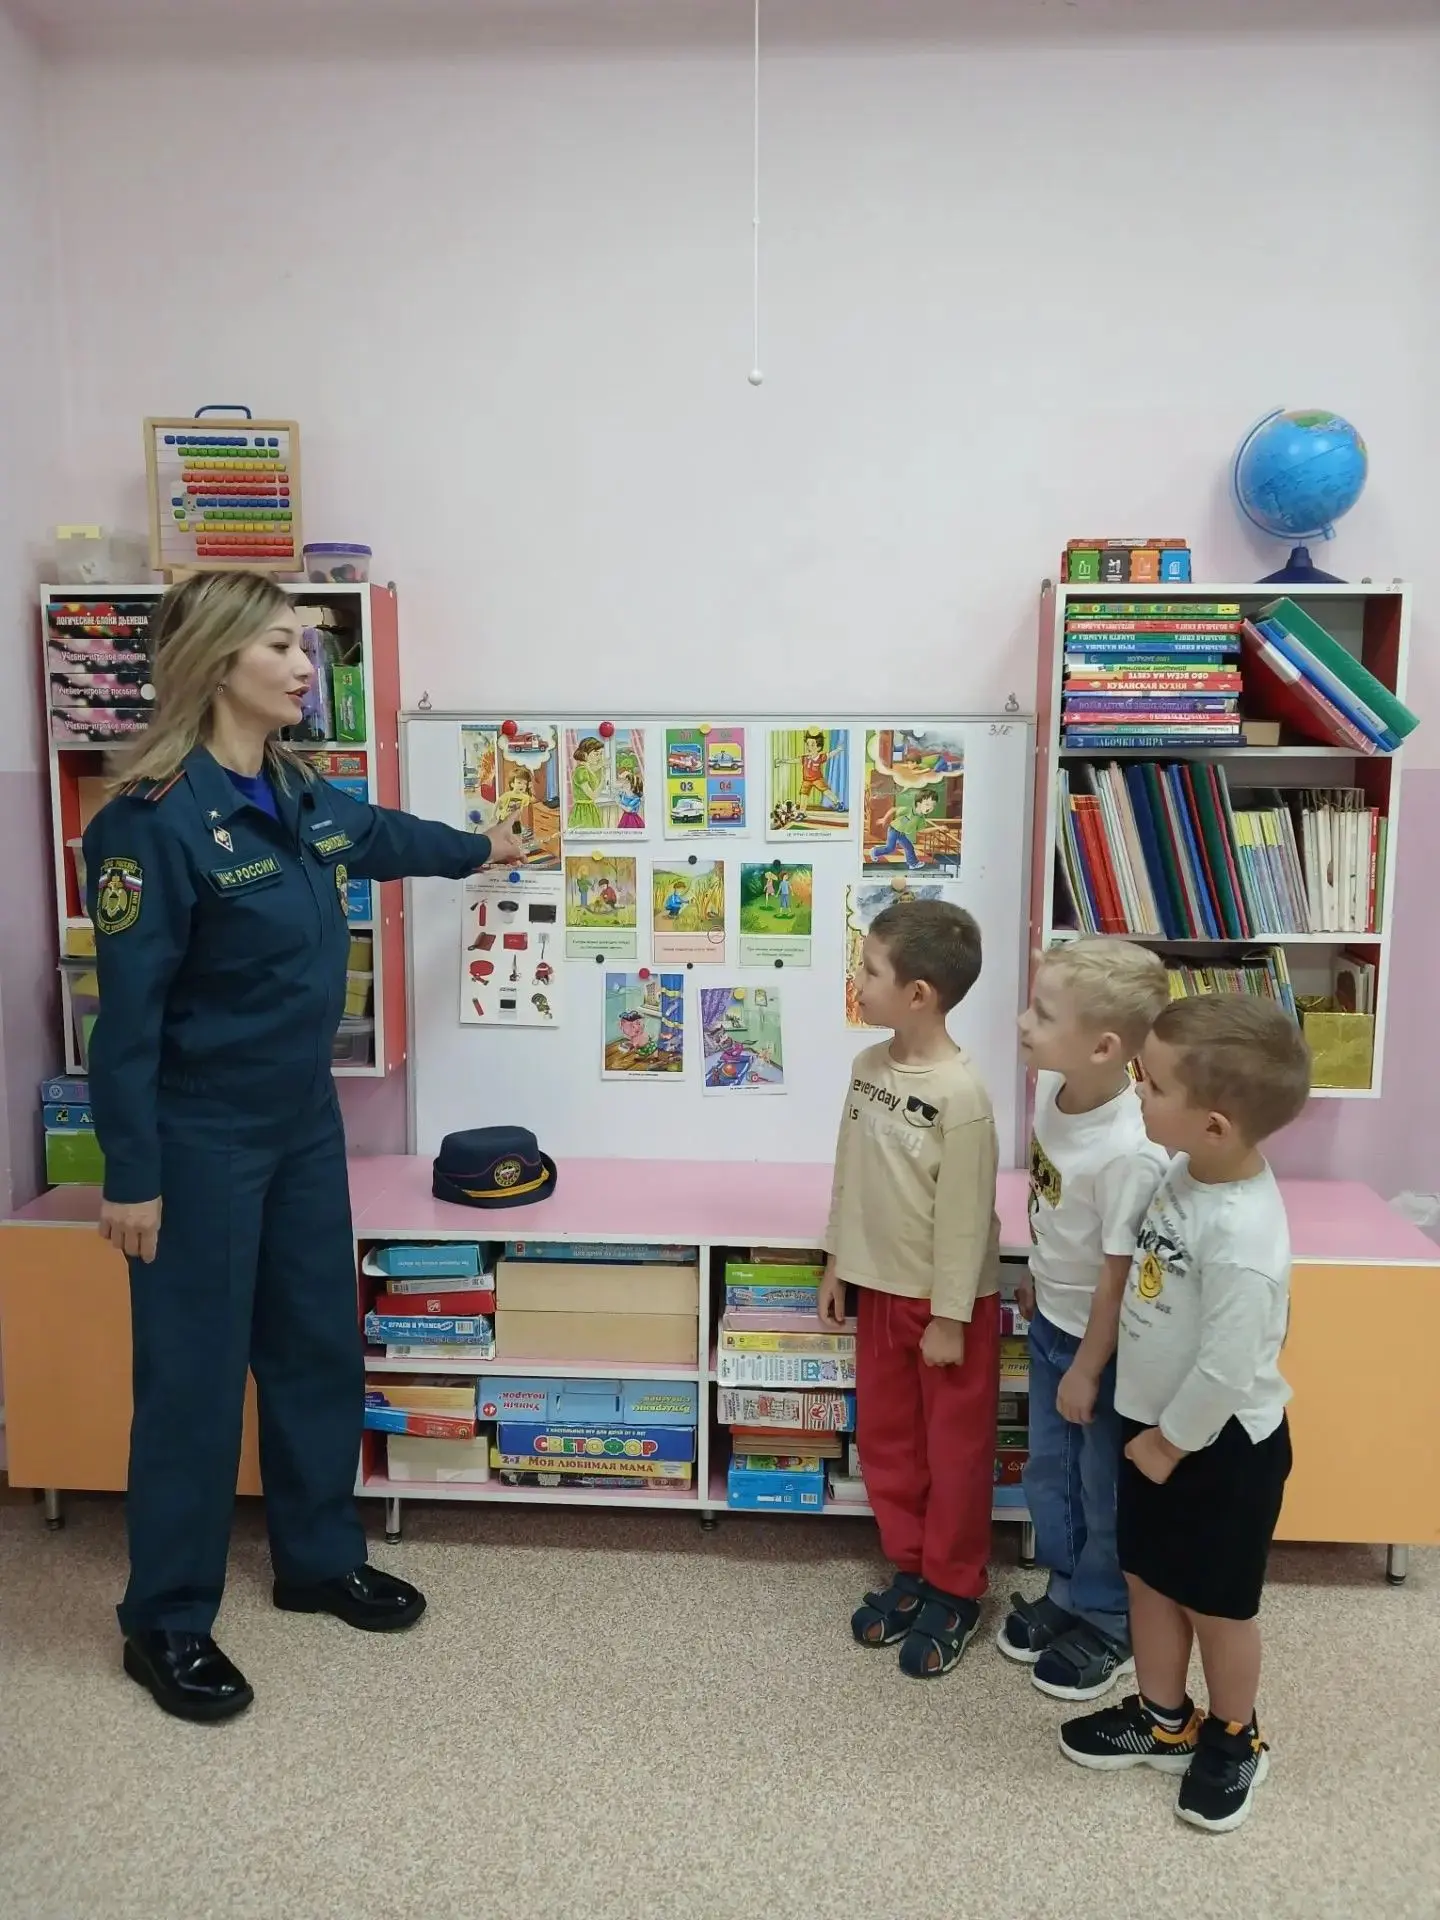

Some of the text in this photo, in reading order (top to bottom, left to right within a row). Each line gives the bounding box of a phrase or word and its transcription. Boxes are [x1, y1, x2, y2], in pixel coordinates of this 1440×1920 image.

[1139, 737, 1163, 747] МИРА
[680, 781, 694, 791] 03
[236, 858, 276, 881] РОССИИ
[853, 1079, 901, 1111] everyday
[848, 1104, 859, 1120] is
[533, 1435, 658, 1457] СВЕТОФОР
